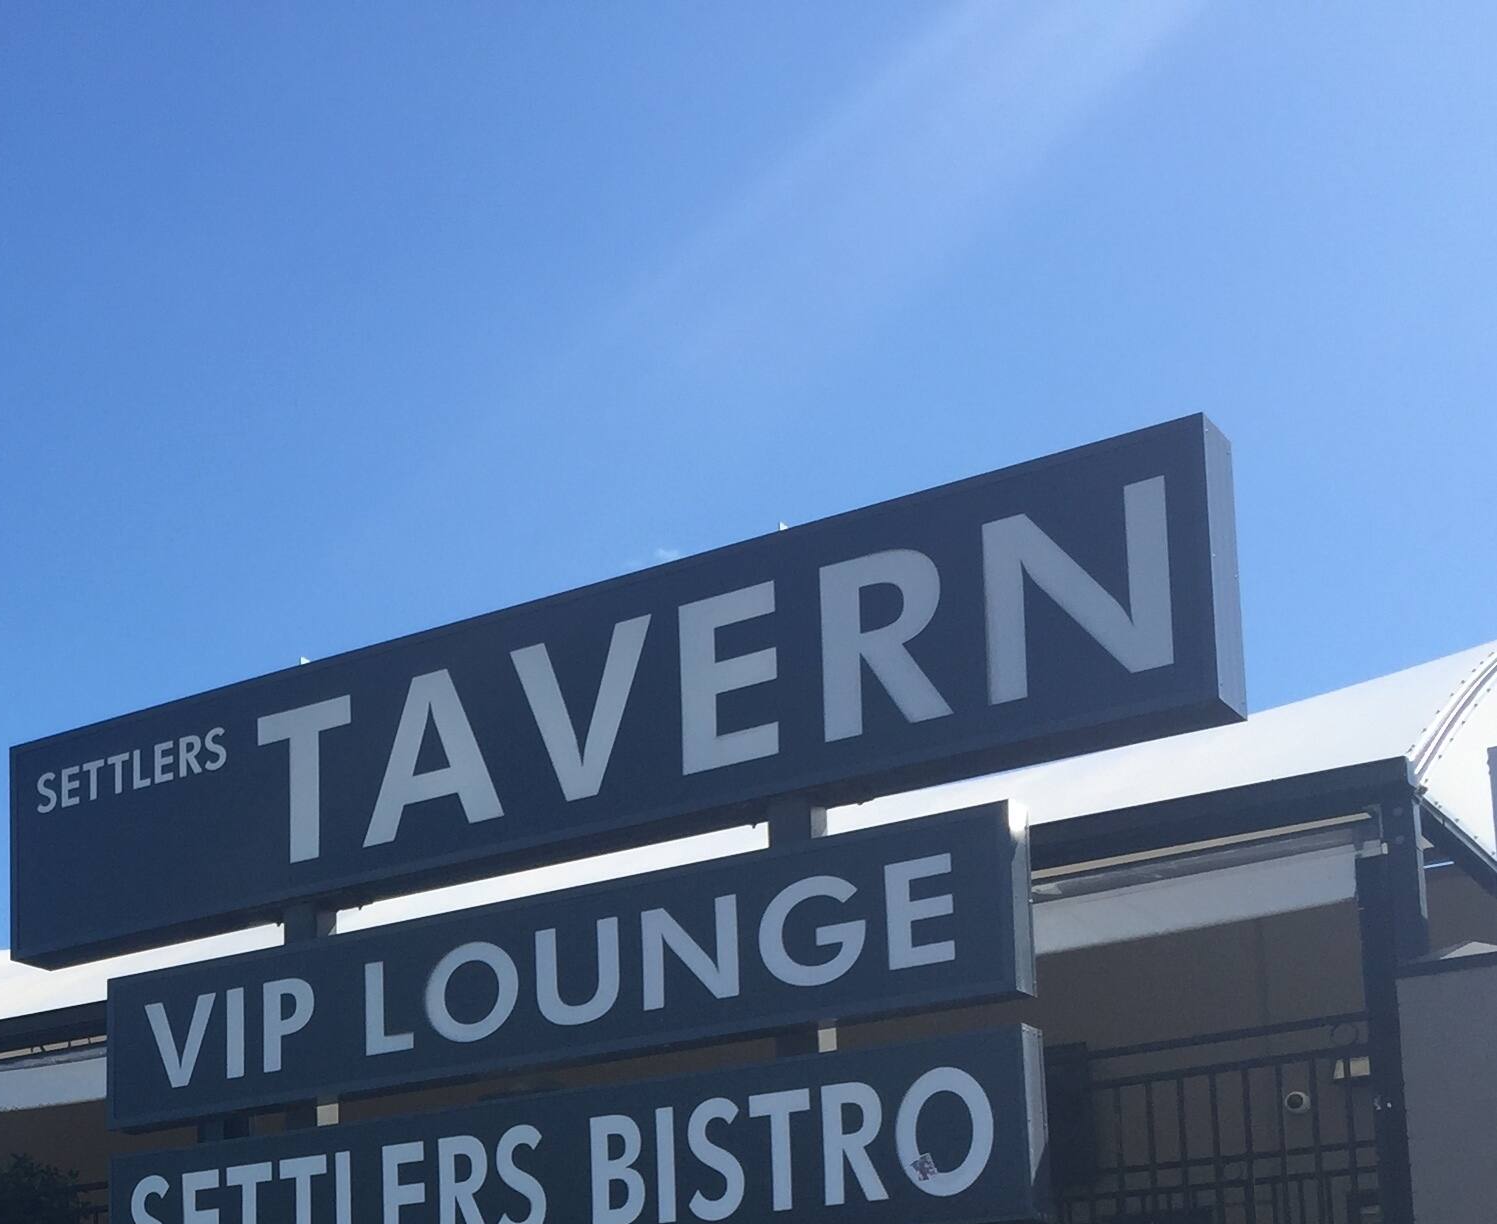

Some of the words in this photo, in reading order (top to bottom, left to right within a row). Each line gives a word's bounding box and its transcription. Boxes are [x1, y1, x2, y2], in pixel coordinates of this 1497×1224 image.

[37, 727, 226, 813] SETTLERS
[258, 475, 1174, 863] TAVERN
[145, 978, 315, 1088] VIP
[365, 853, 956, 1055] LOUNGE
